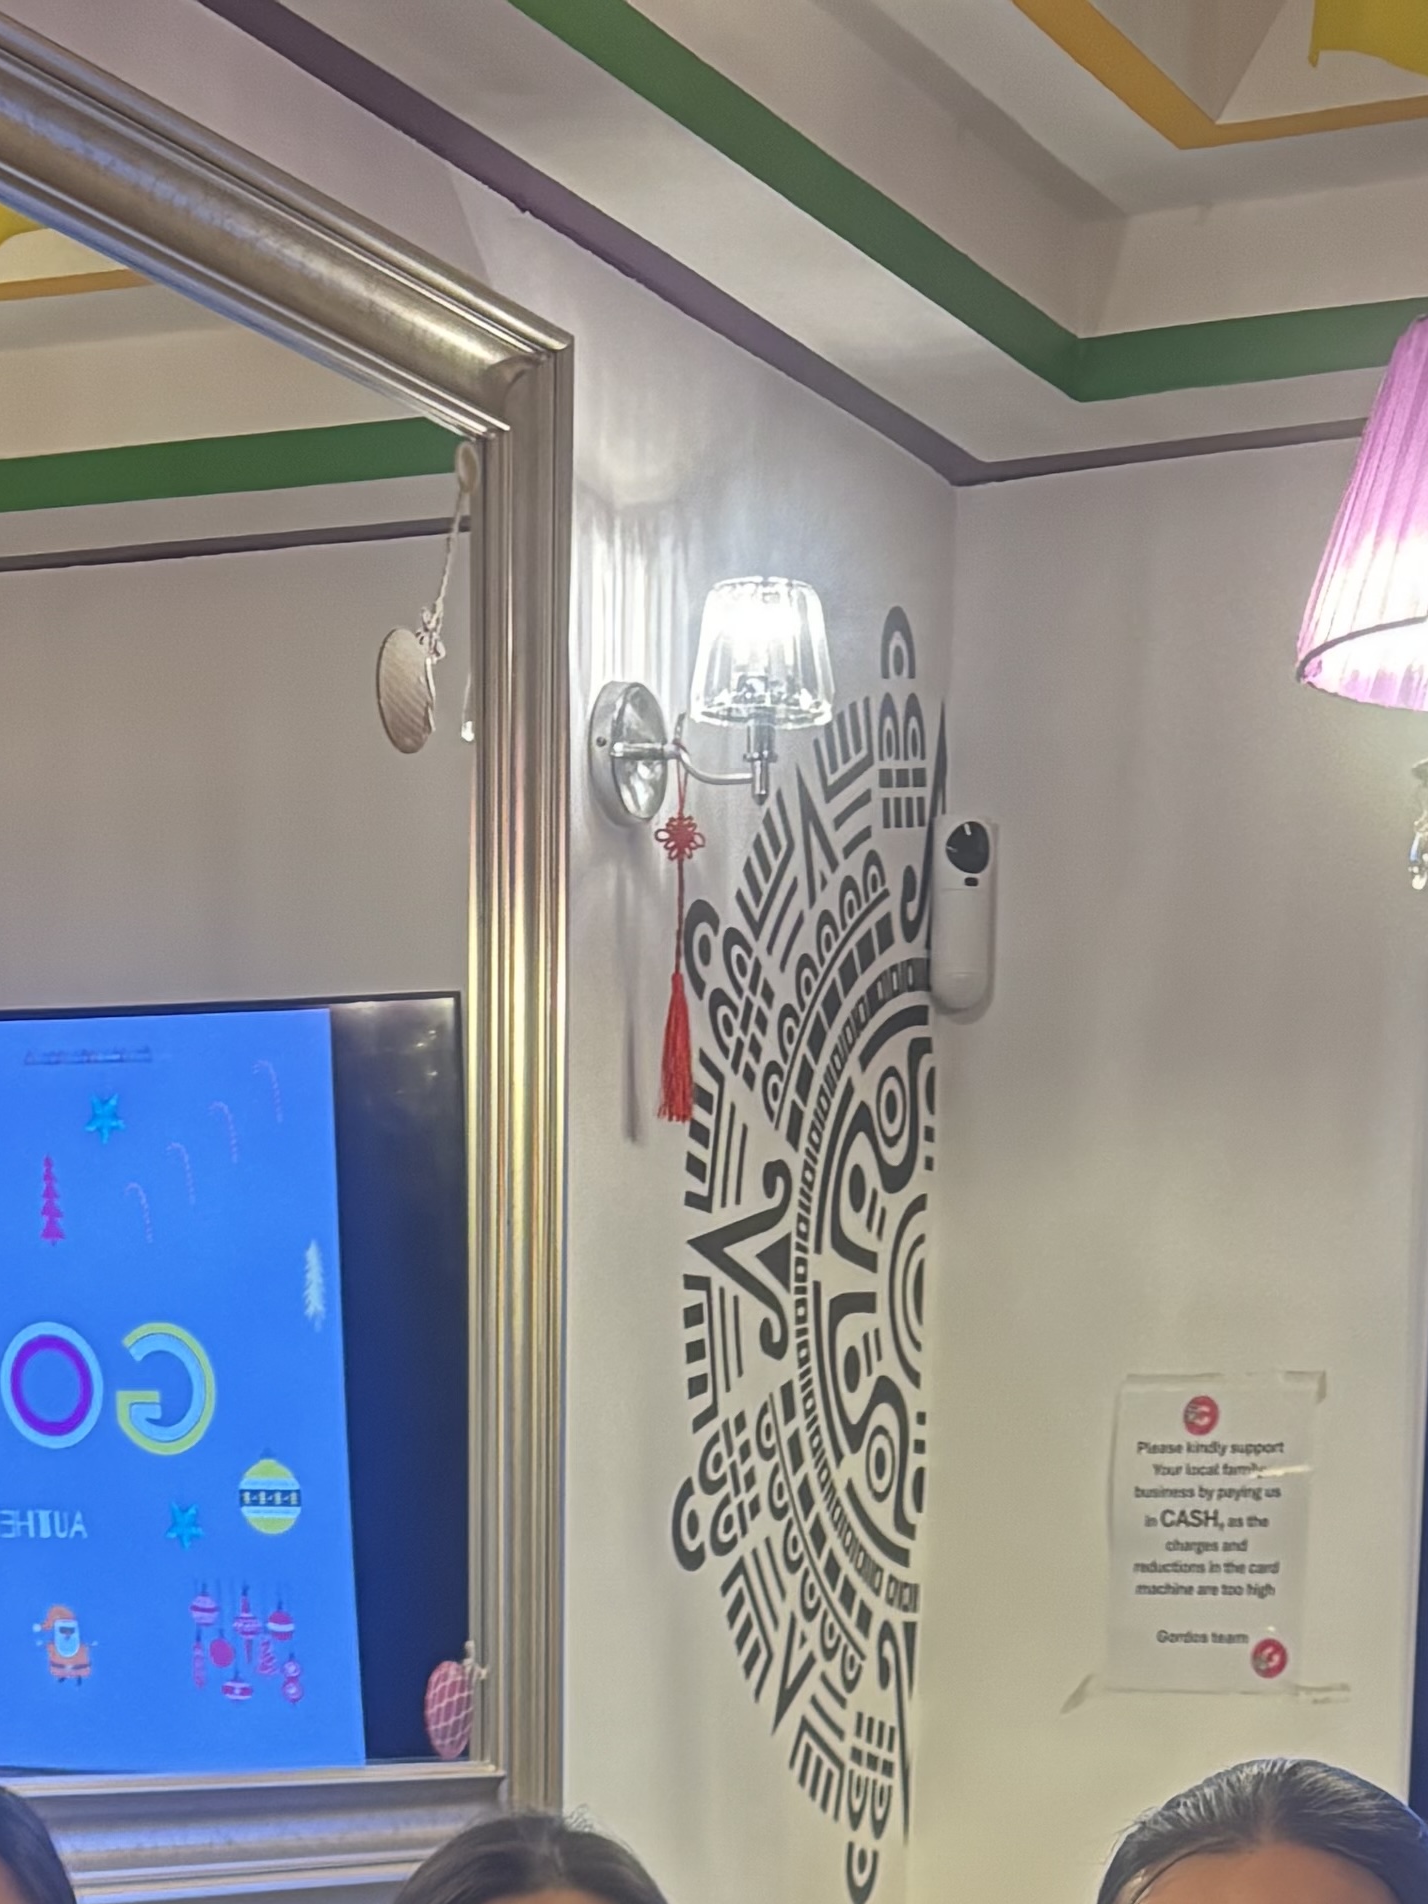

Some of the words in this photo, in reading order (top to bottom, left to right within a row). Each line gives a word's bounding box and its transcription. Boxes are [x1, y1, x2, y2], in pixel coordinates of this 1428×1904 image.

[1136, 1441, 1183, 1454] Please
[1186, 1441, 1226, 1456] kindly
[1230, 1442, 1285, 1456] support
[1152, 1463, 1183, 1476] Your
[1185, 1463, 1220, 1476] local
[1134, 1486, 1195, 1498] business
[1198, 1485, 1215, 1500] by
[1217, 1486, 1262, 1501] paying
[1264, 1487, 1281, 1498] us
[1144, 1515, 1158, 1528] in
[1160, 1509, 1225, 1531] CASH,
[1227, 1517, 1243, 1528] as
[1246, 1515, 1269, 1528] the
[1165, 1539, 1219, 1555] charges
[1222, 1539, 1248, 1552] and
[1133, 1559, 1206, 1574] reductions
[1208, 1560, 1221, 1573] in
[1223, 1560, 1246, 1574] the
[1248, 1560, 1280, 1574] card
[1135, 1583, 1194, 1596] machine
[1196, 1584, 1219, 1596] are
[1221, 1584, 1244, 1596] too
[1246, 1583, 1275, 1599] high
[1211, 1631, 1249, 1644] team
